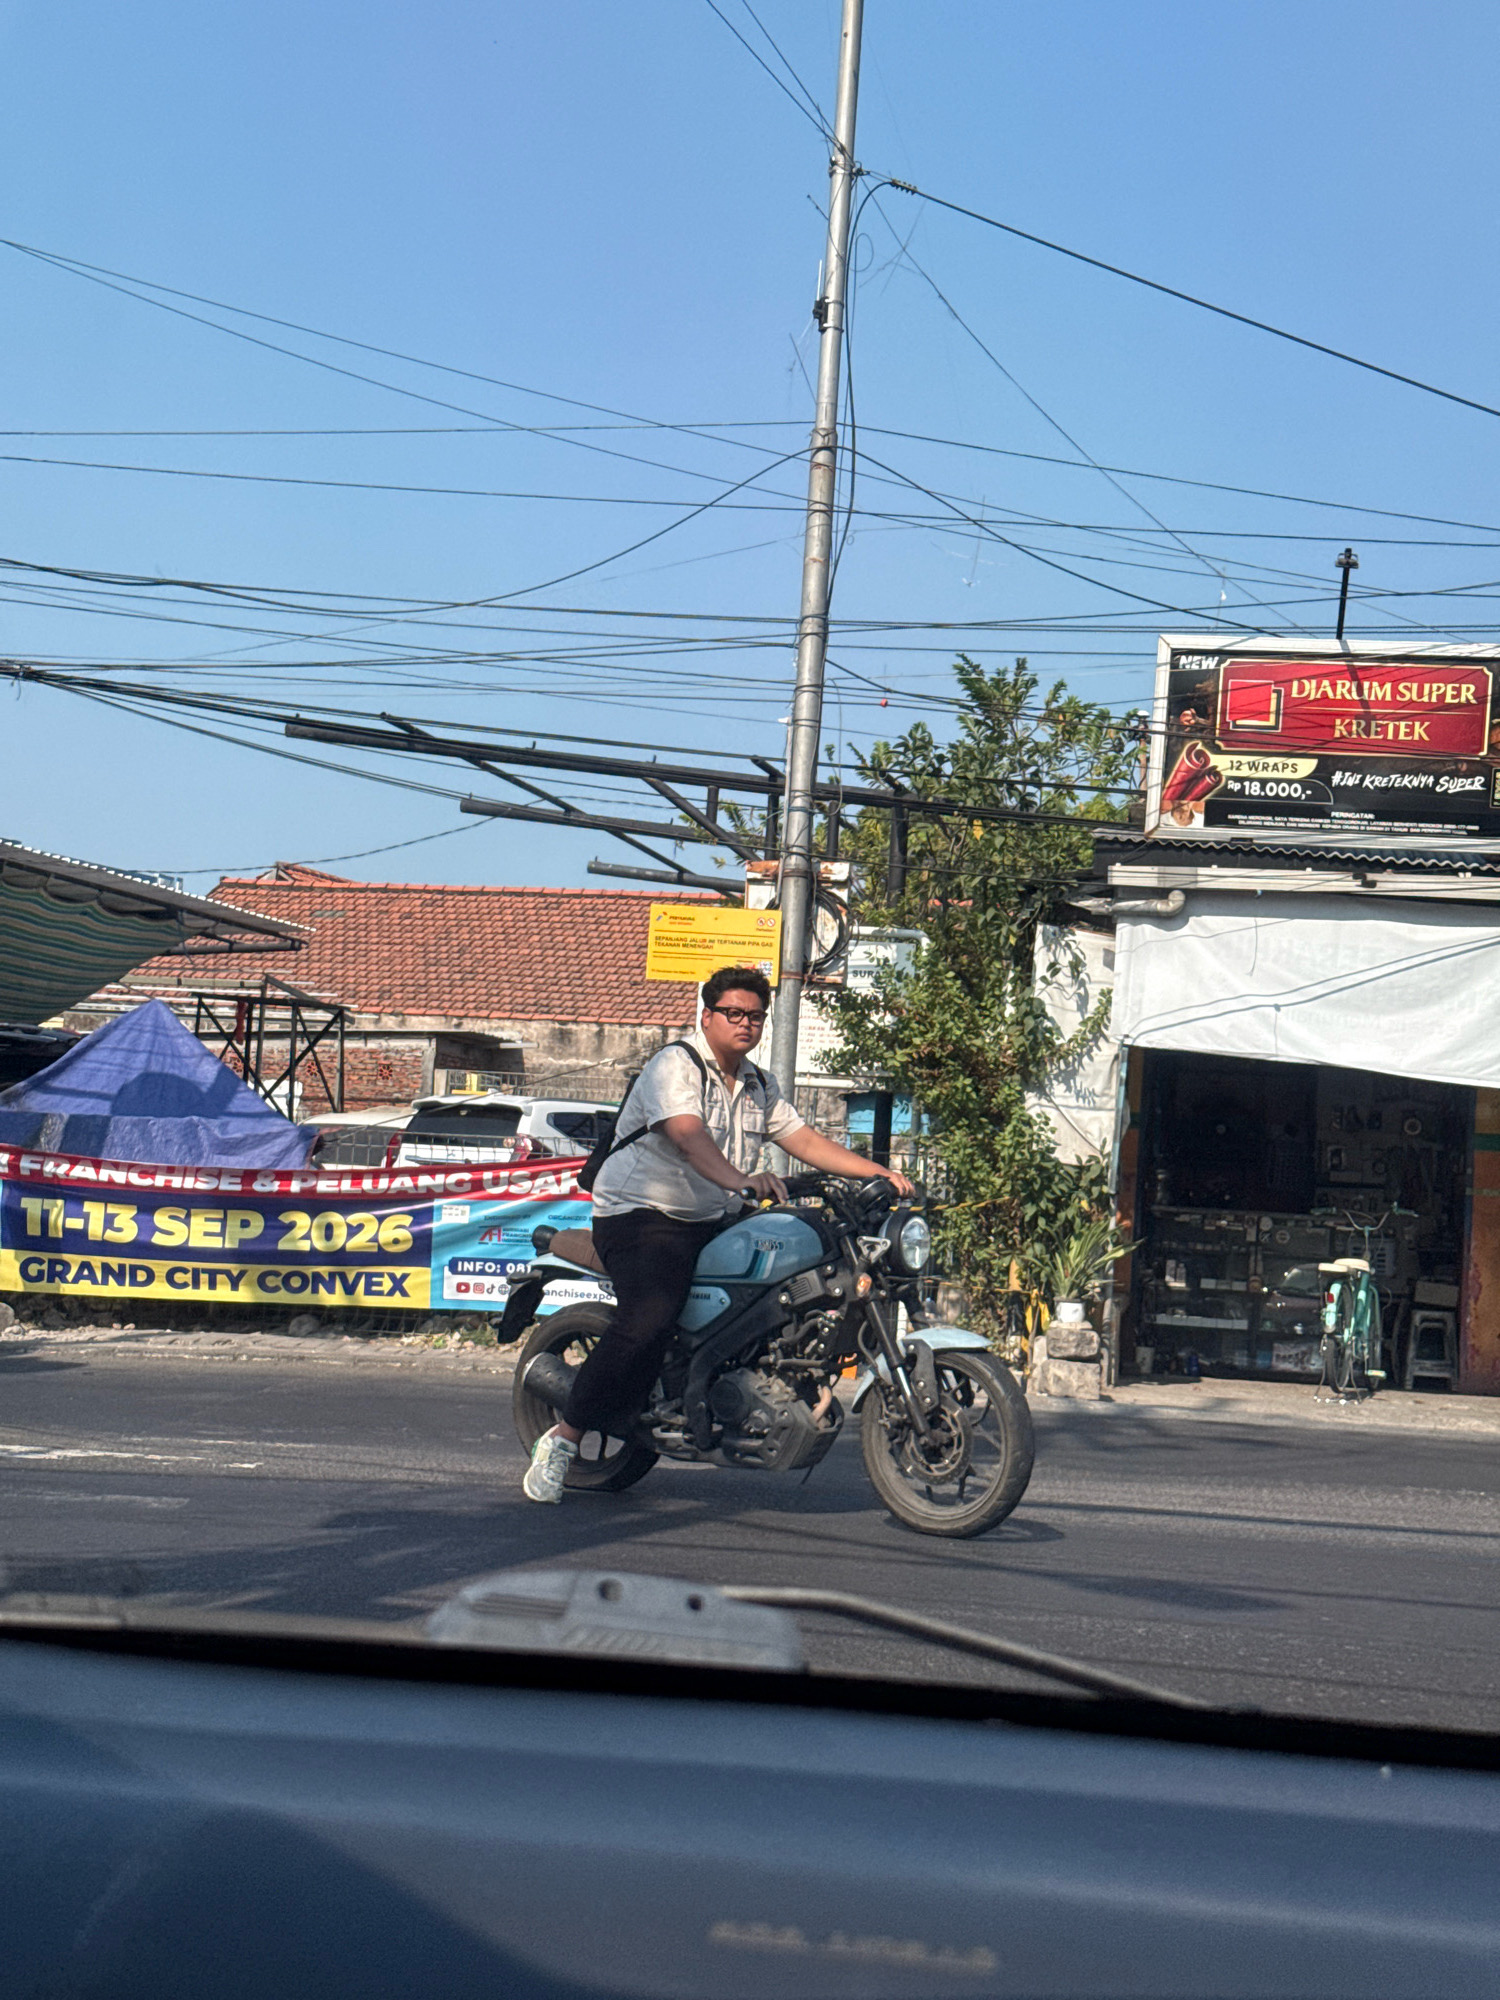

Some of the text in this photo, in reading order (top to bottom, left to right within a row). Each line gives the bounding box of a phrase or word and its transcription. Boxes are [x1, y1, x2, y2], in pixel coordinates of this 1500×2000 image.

[1179, 655, 1219, 669] NEW
[1291, 679, 1478, 704] DJARUM SUPER
[1333, 718, 1431, 741] KRETEK
[1229, 760, 1299, 774] 12 WRAPS
[1227, 780, 1312, 801] Rp 18.000,-
[19, 1153, 243, 1192] FRANCHISE
[252, 1170, 281, 1193] &
[290, 1171, 473, 1194] PELUANG
[20, 1197, 414, 1253] 11-13 SEP 2026
[19, 1256, 411, 1297] GRAND CITY CONVEX
[457, 1260, 500, 1274] INFO:
[543, 1288, 613, 1302] anchiseexpo
